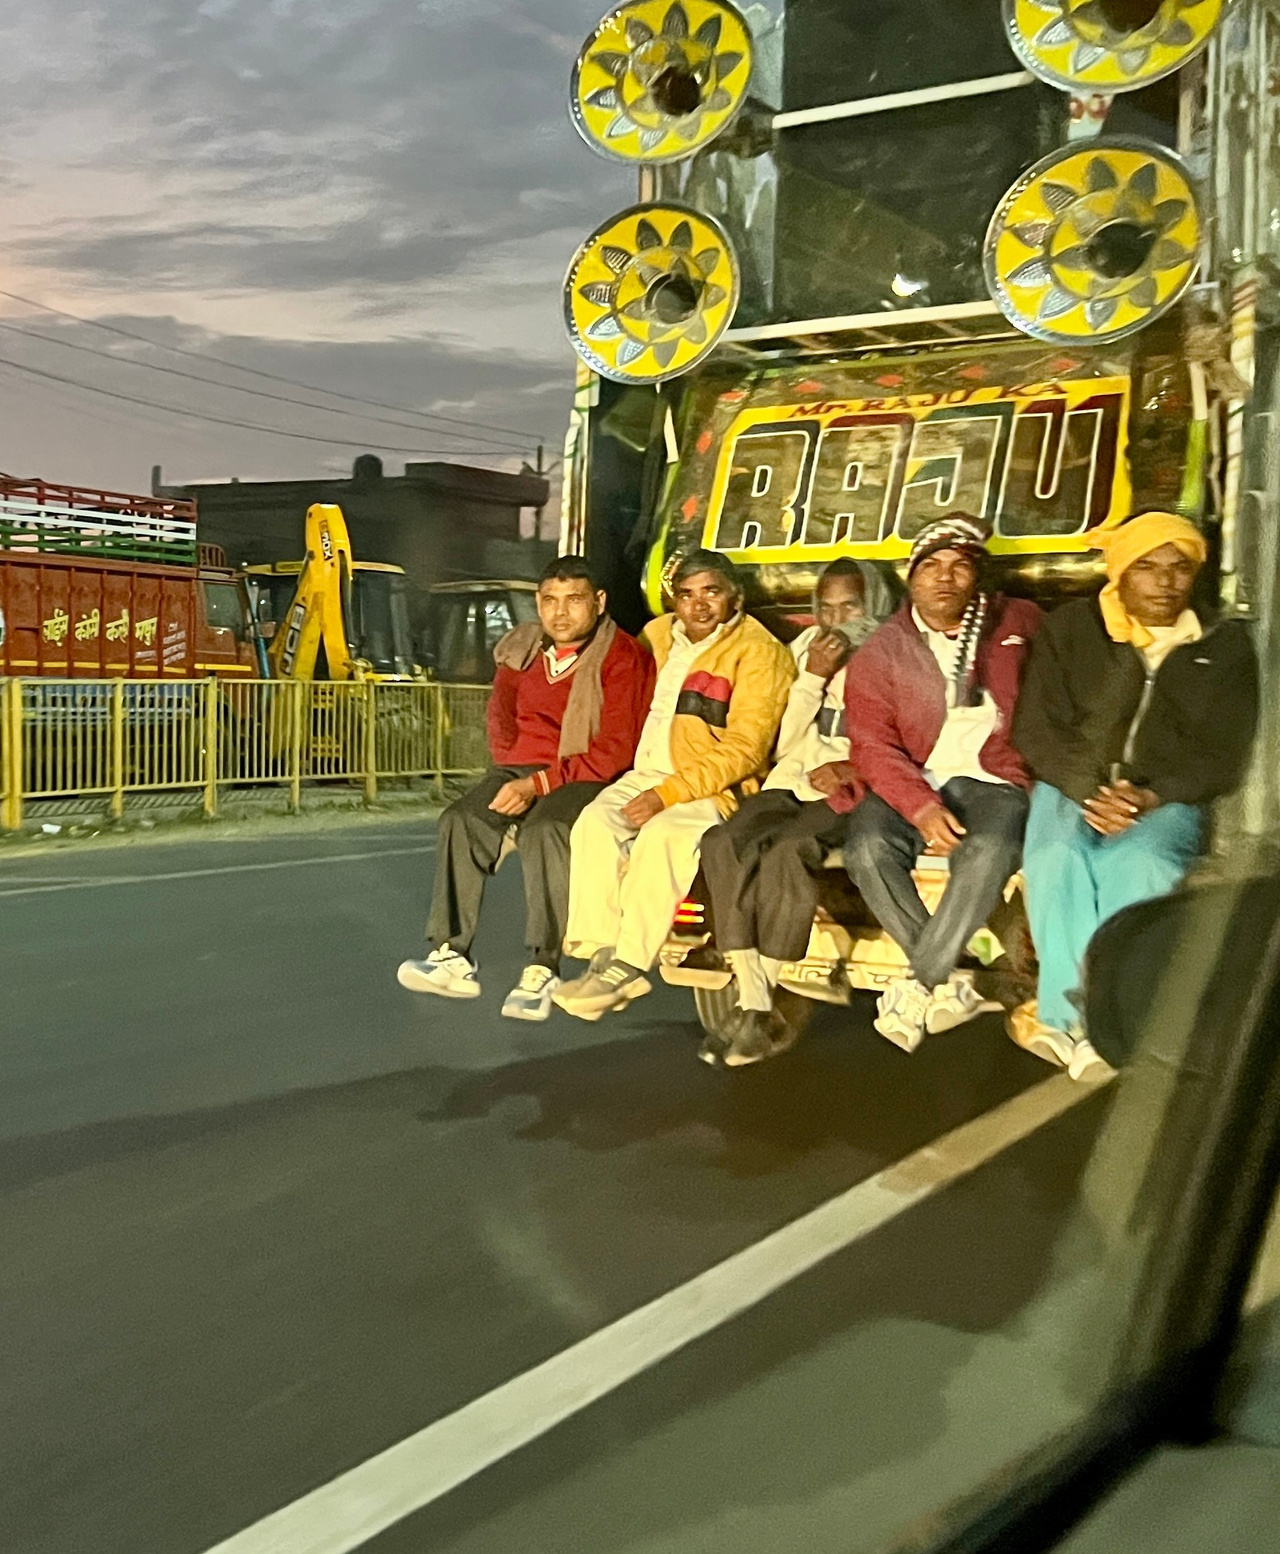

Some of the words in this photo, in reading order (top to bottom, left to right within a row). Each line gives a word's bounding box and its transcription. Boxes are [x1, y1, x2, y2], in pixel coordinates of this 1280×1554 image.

[789, 401, 846, 418] Mr.
[862, 389, 975, 412] RAJU
[997, 383, 1067, 400] KA
[714, 392, 1125, 550] RAJU
[282, 604, 306, 676] JCB
